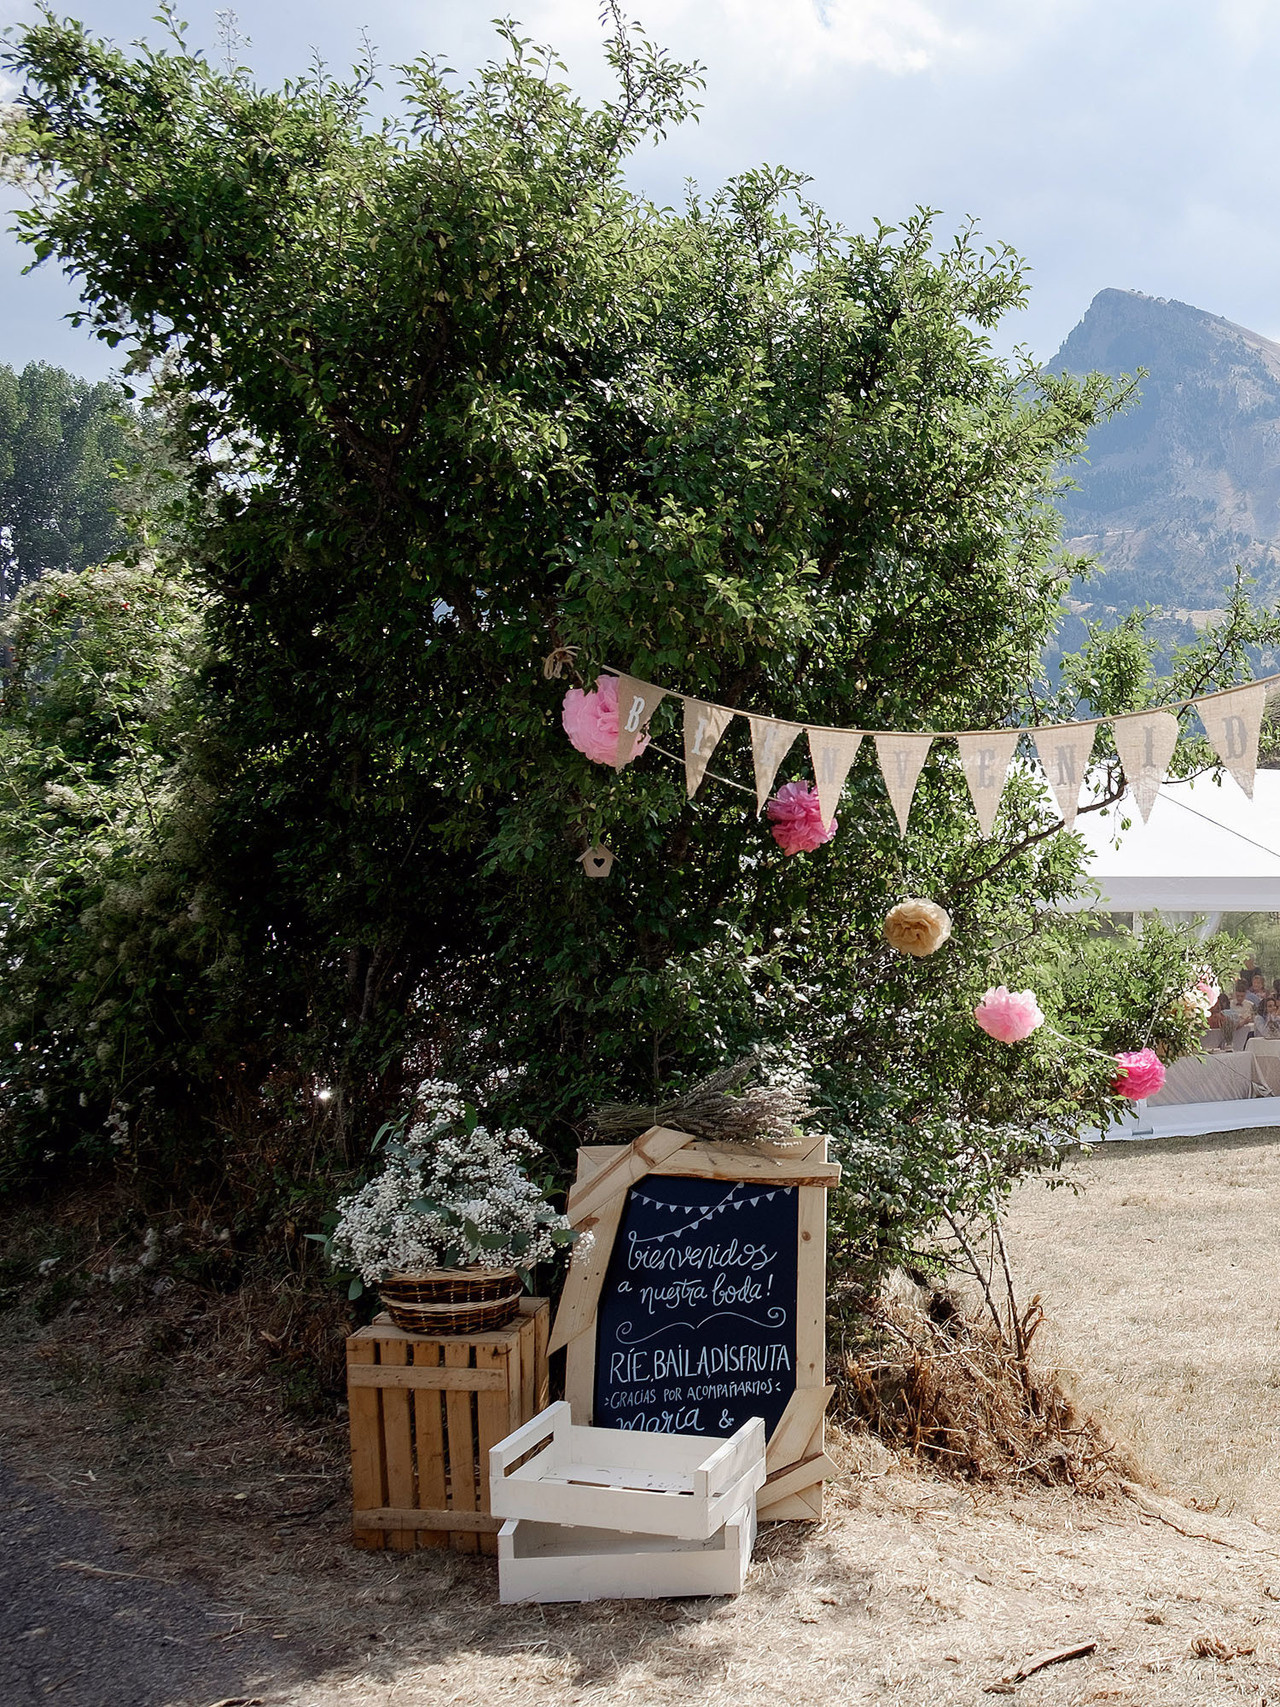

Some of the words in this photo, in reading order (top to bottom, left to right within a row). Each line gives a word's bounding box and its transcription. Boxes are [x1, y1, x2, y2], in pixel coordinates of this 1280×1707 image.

[628, 1230, 778, 1271] bienvenidos
[617, 1280, 633, 1293] a
[640, 1278, 709, 1315] nuestra
[712, 1272, 774, 1306] boda!
[710, 1343, 791, 1374] DISFRUTA
[663, 1386, 682, 1402] POR
[686, 1378, 773, 1401] ACOMPAÑARNOS
